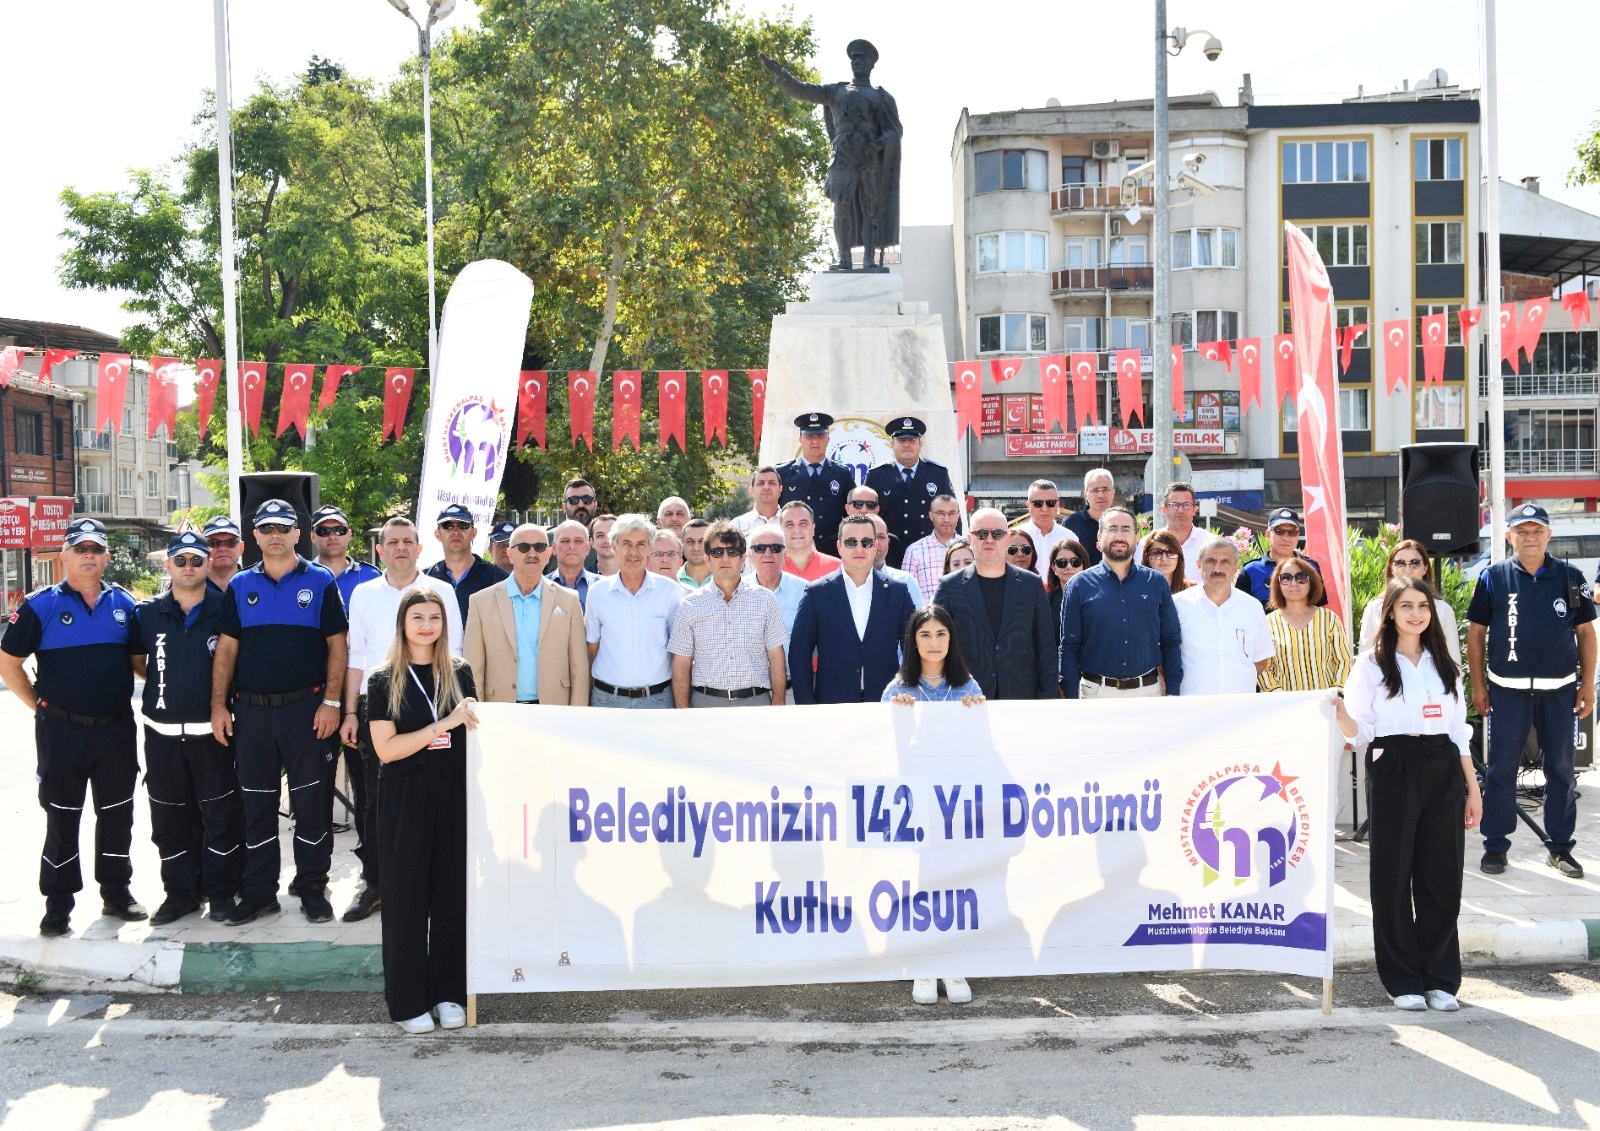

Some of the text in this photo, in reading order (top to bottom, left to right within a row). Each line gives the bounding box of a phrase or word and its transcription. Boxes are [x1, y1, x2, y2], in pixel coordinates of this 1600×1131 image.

[1024, 441, 1050, 449] SAADET
[1051, 439, 1075, 448] PARTİSİ
[1174, 433, 1220, 444] EMLAK
[42, 504, 64, 518] TOSTÇU
[0, 515, 20, 526] OSTÇU
[11, 527, 26, 536] YERİ
[1507, 593, 1518, 662] ZABITA
[155, 633, 167, 710] ZABITA
[569, 779, 1162, 858] Belediyemizin 142. Yıl Dönümü
[1181, 764, 1260, 867] MUSTAFAKEMALPAŞA
[1288, 787, 1310, 868] BELEDİYESİ
[755, 880, 979, 934] Kutlu Olsun
[1148, 903, 1285, 921] Mehmet KANAR
[1147, 925, 1286, 937] Mustafakemalpaşa Belediye Başkanı
